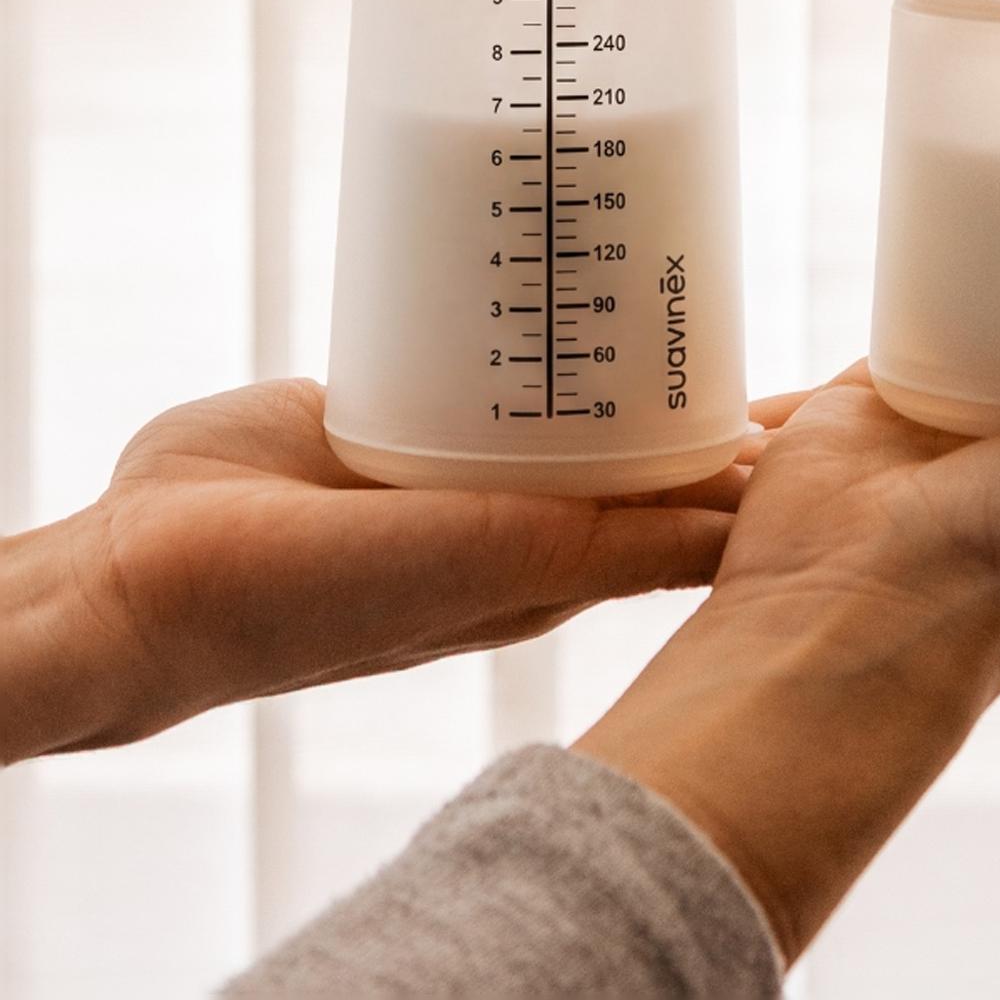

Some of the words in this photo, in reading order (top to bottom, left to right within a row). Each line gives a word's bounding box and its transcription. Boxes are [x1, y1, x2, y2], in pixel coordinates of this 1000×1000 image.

[592, 34, 626, 52] 240
[491, 44, 503, 61] 8
[491, 97, 503, 114] 7
[592, 88, 626, 106] 210
[592, 139, 627, 158] 180
[491, 149, 503, 167] 6
[491, 201, 503, 218] 5
[592, 192, 627, 211] 150
[489, 251, 502, 268] 4
[592, 243, 627, 262] 120
[490, 301, 503, 318] 3
[592, 295, 616, 313] 90
[489, 350, 502, 366] 2
[592, 346, 616, 363] 60
[490, 403, 500, 421] 1
[592, 401, 616, 419] 30
